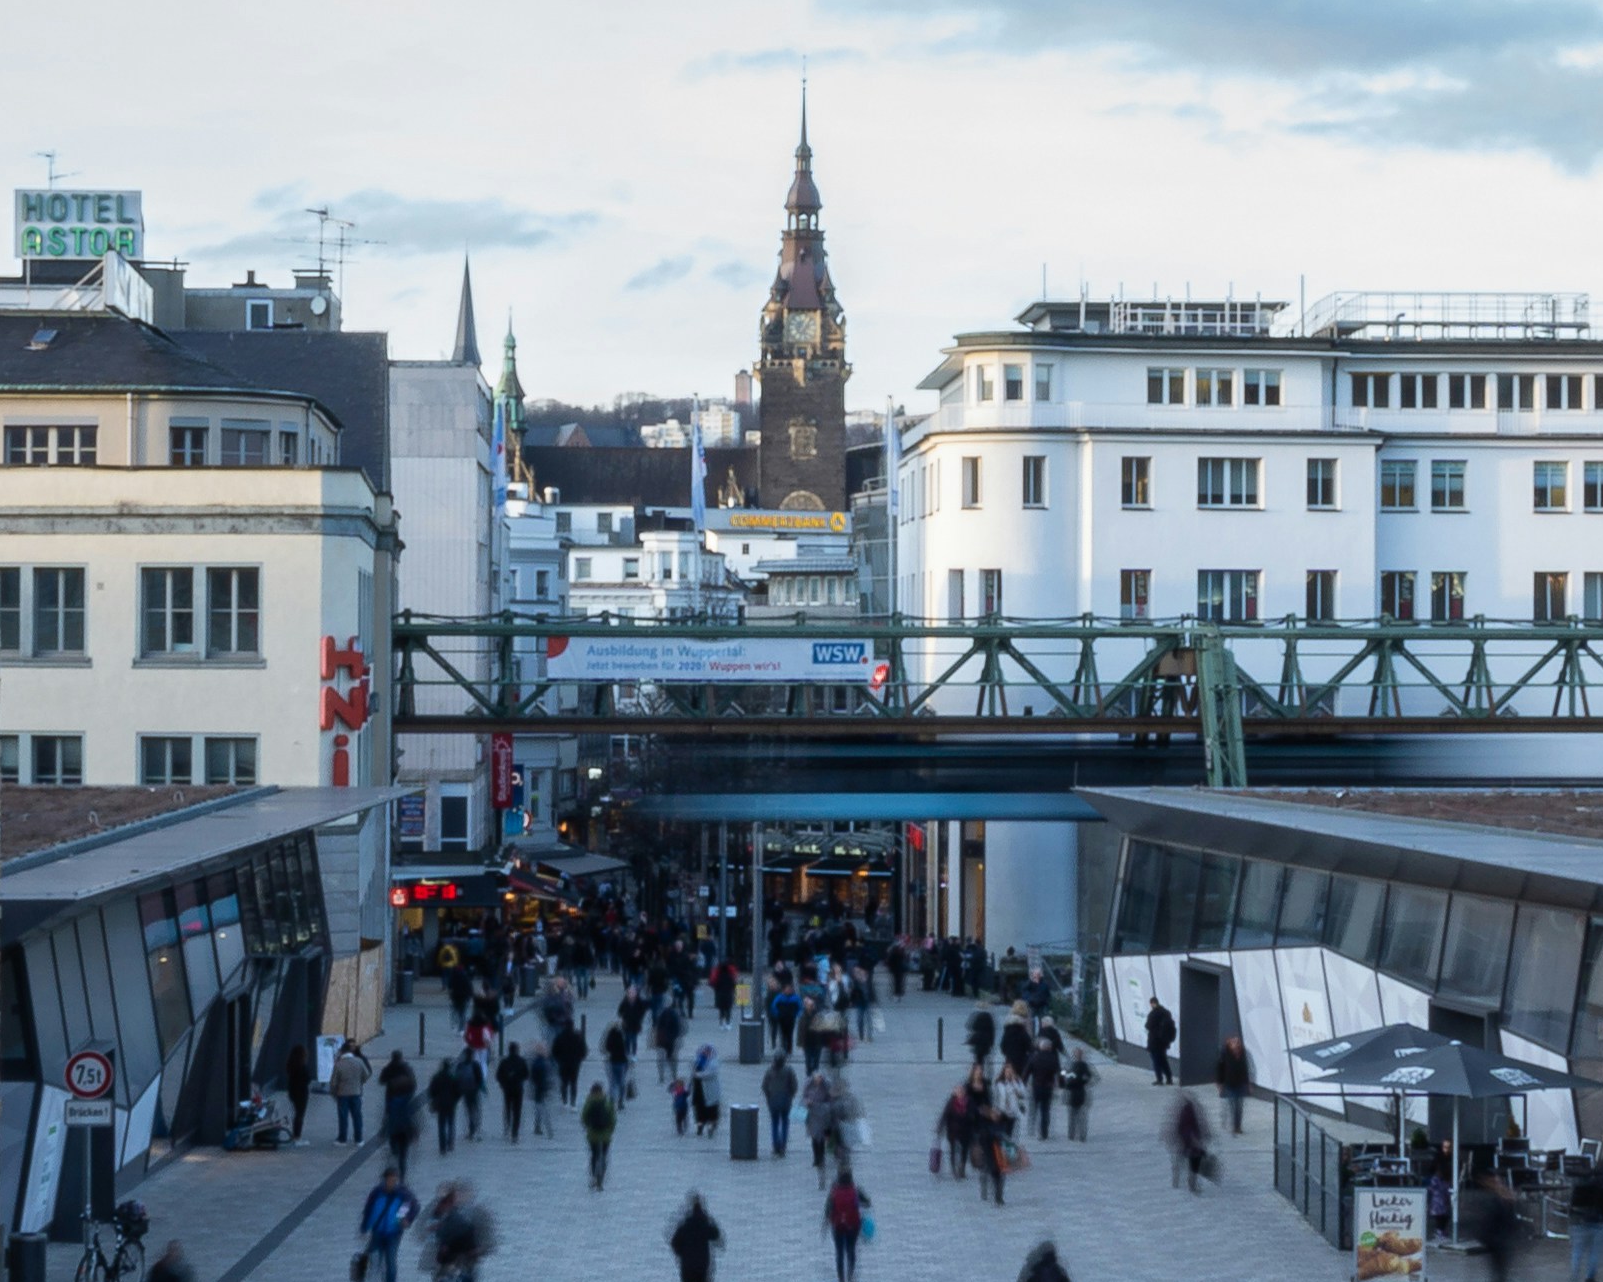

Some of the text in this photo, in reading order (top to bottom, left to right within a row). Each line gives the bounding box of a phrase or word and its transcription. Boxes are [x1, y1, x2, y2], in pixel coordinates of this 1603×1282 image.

[21, 193, 135, 223] HOTEL
[21, 226, 136, 256] ASTOR
[587, 644, 657, 659] Ausbildung
[662, 644, 673, 656] in
[815, 645, 860, 662] WSW
